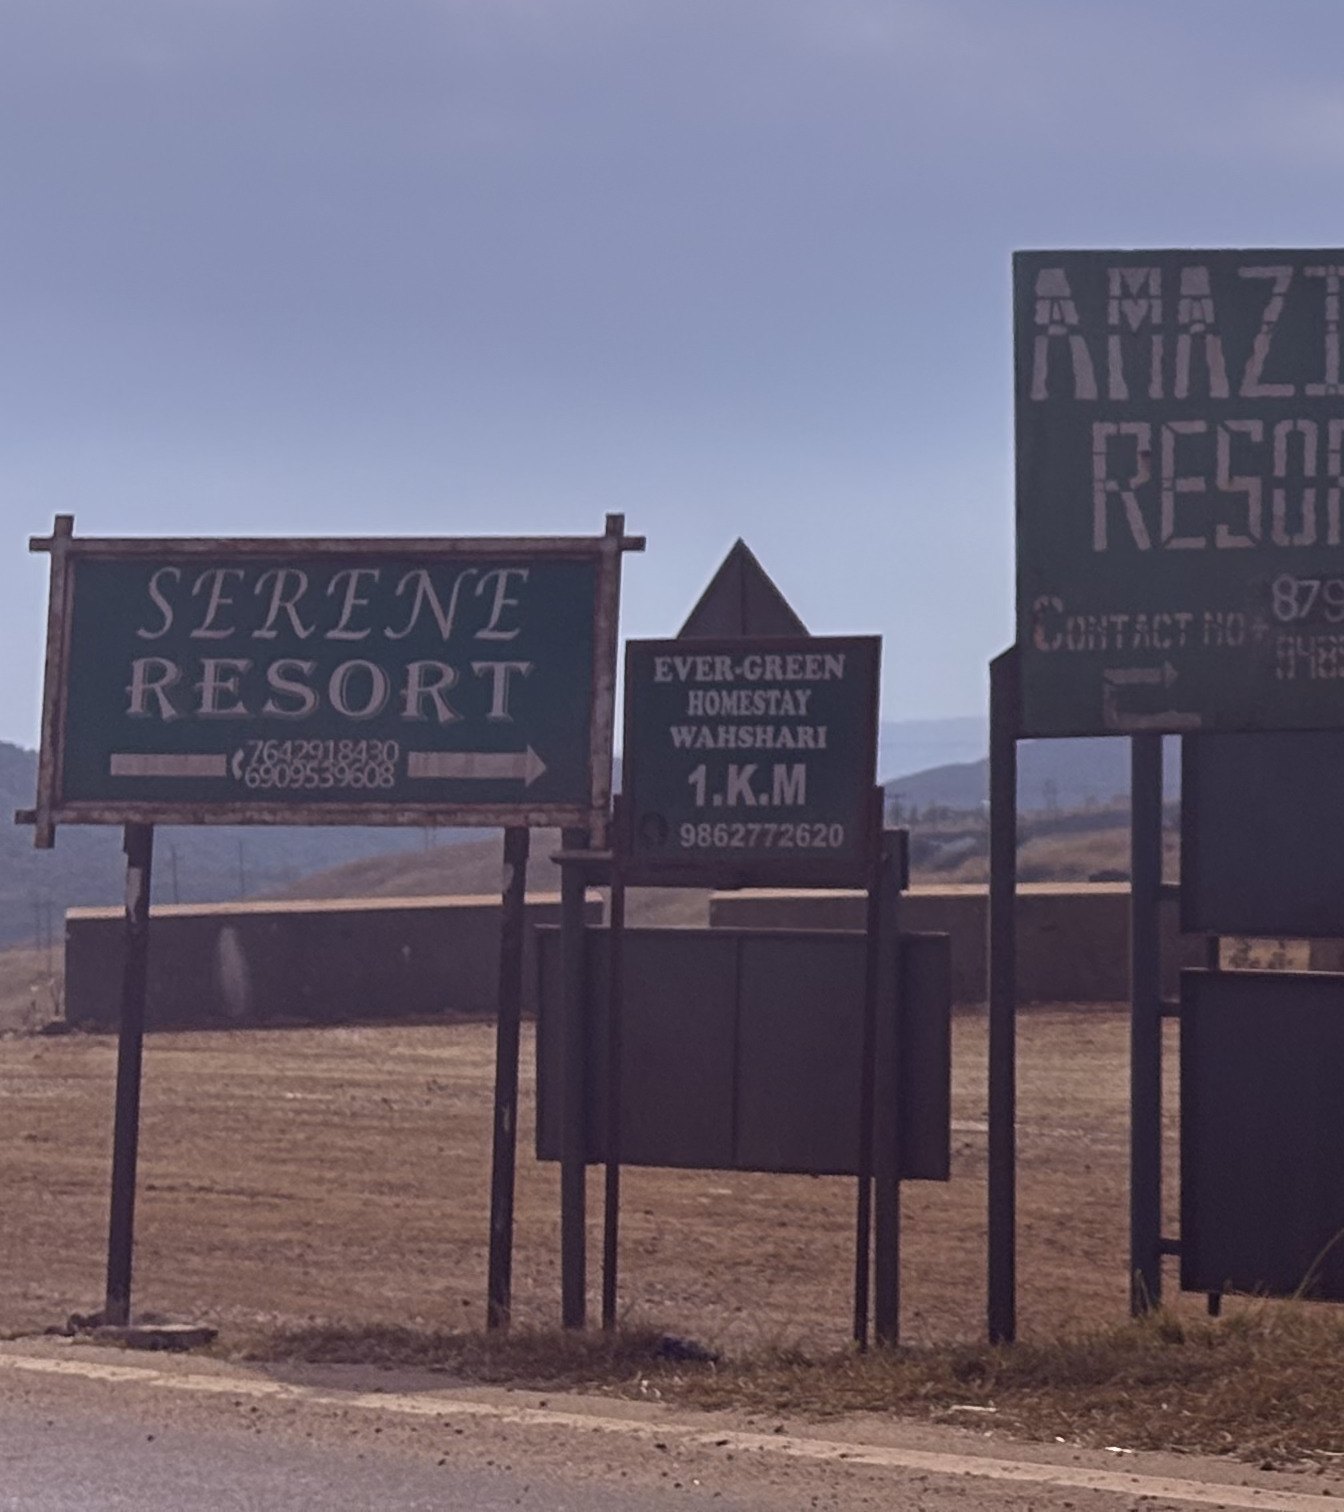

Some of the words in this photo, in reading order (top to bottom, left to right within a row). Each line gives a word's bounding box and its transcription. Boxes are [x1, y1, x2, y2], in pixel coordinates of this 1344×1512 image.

[136, 566, 530, 641] SERENE
[654, 654, 846, 682] EVER-GREEN
[126, 657, 534, 722] RESORT
[688, 690, 812, 716] HOMESTAY
[670, 725, 828, 749] WAHSHARI
[248, 739, 399, 764] 7642918430
[680, 823, 845, 848] 9862772620
